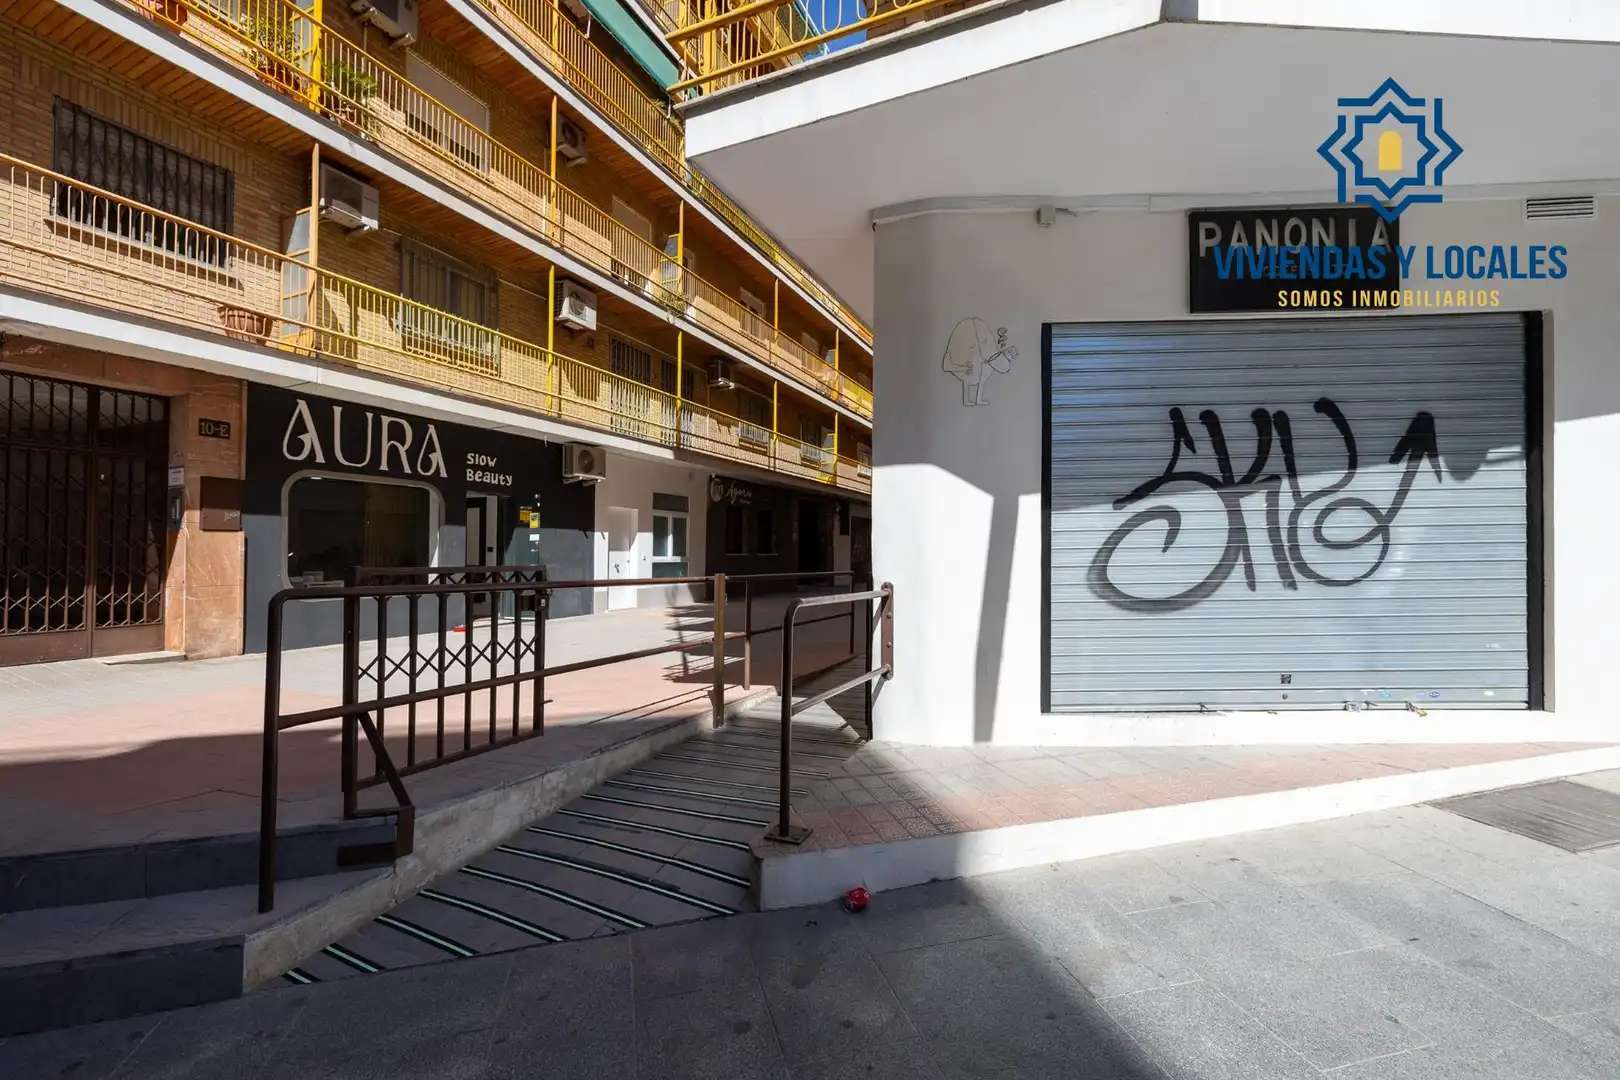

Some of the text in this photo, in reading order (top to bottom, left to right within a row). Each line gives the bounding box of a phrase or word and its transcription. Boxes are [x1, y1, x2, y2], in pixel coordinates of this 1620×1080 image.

[1199, 216, 1391, 257] PANONIA
[200, 421, 229, 437] 10-E
[282, 399, 448, 478] AURA
[466, 469, 513, 486] Beauty
